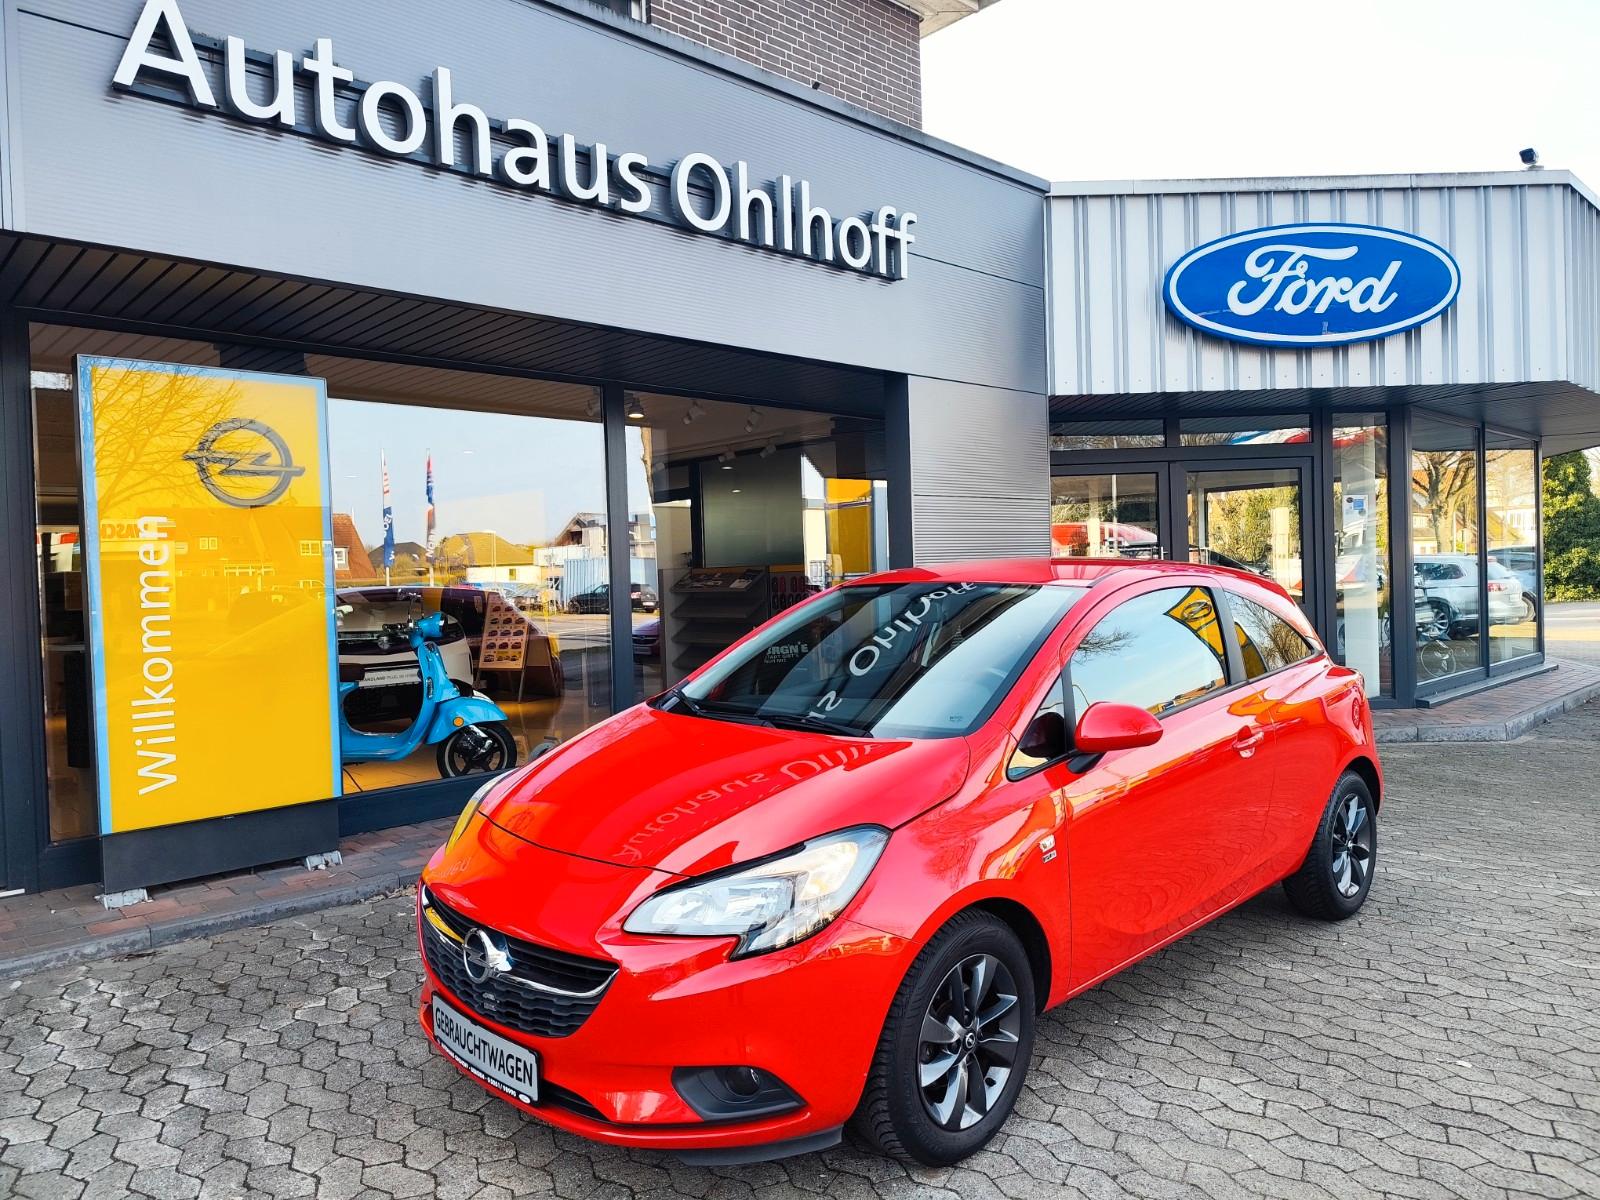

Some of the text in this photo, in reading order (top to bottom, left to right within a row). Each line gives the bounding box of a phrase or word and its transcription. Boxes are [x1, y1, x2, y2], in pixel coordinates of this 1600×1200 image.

[112, 0, 918, 280] Autohaus Ohlhoff
[1227, 244, 1402, 316] Ford
[131, 515, 177, 796] Willkommen
[435, 1007, 533, 1088] GEBRAUCHTWAGEN
